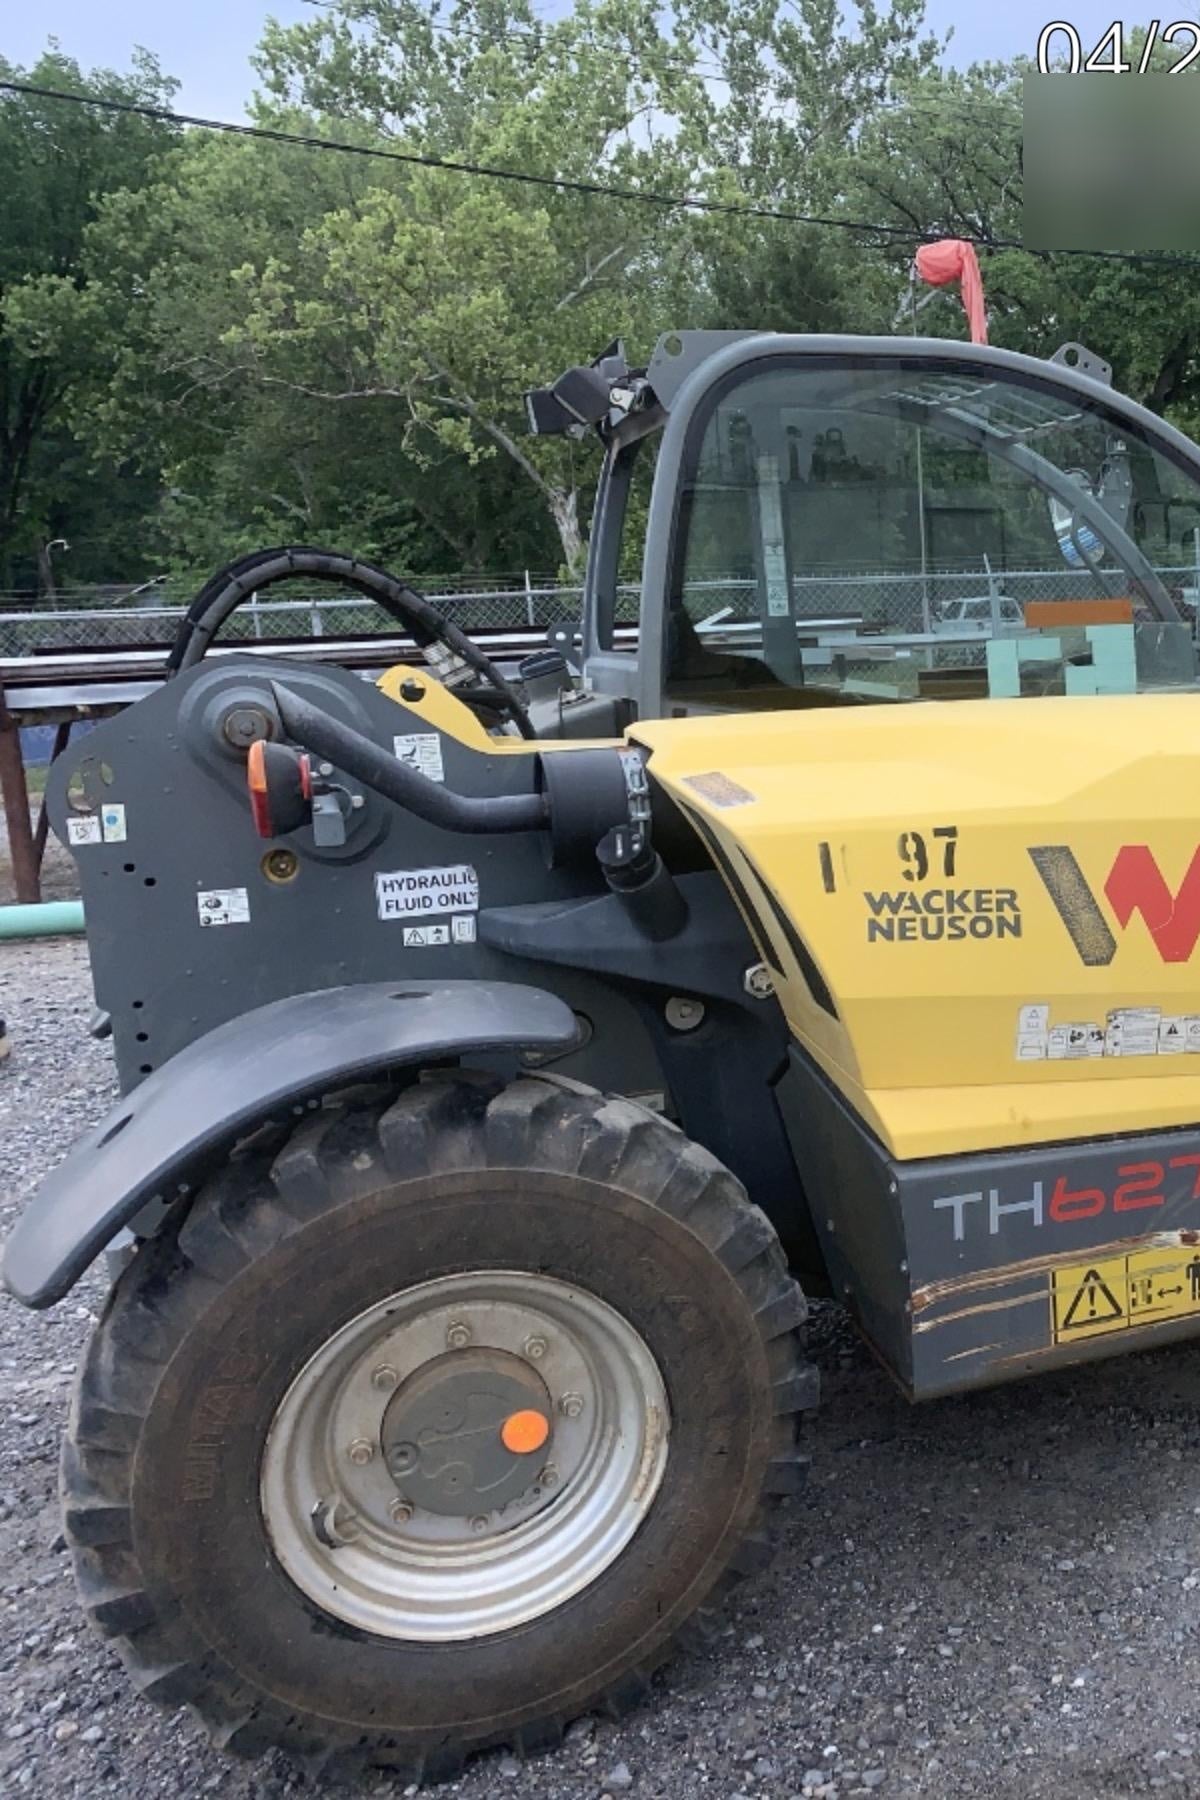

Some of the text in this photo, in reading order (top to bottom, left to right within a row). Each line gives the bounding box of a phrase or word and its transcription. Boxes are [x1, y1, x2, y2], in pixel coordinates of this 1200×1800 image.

[898, 826, 958, 882] 97
[385, 895, 433, 912] FLUID
[863, 889, 1020, 916] WACKER
[867, 914, 1022, 942] NEUSON
